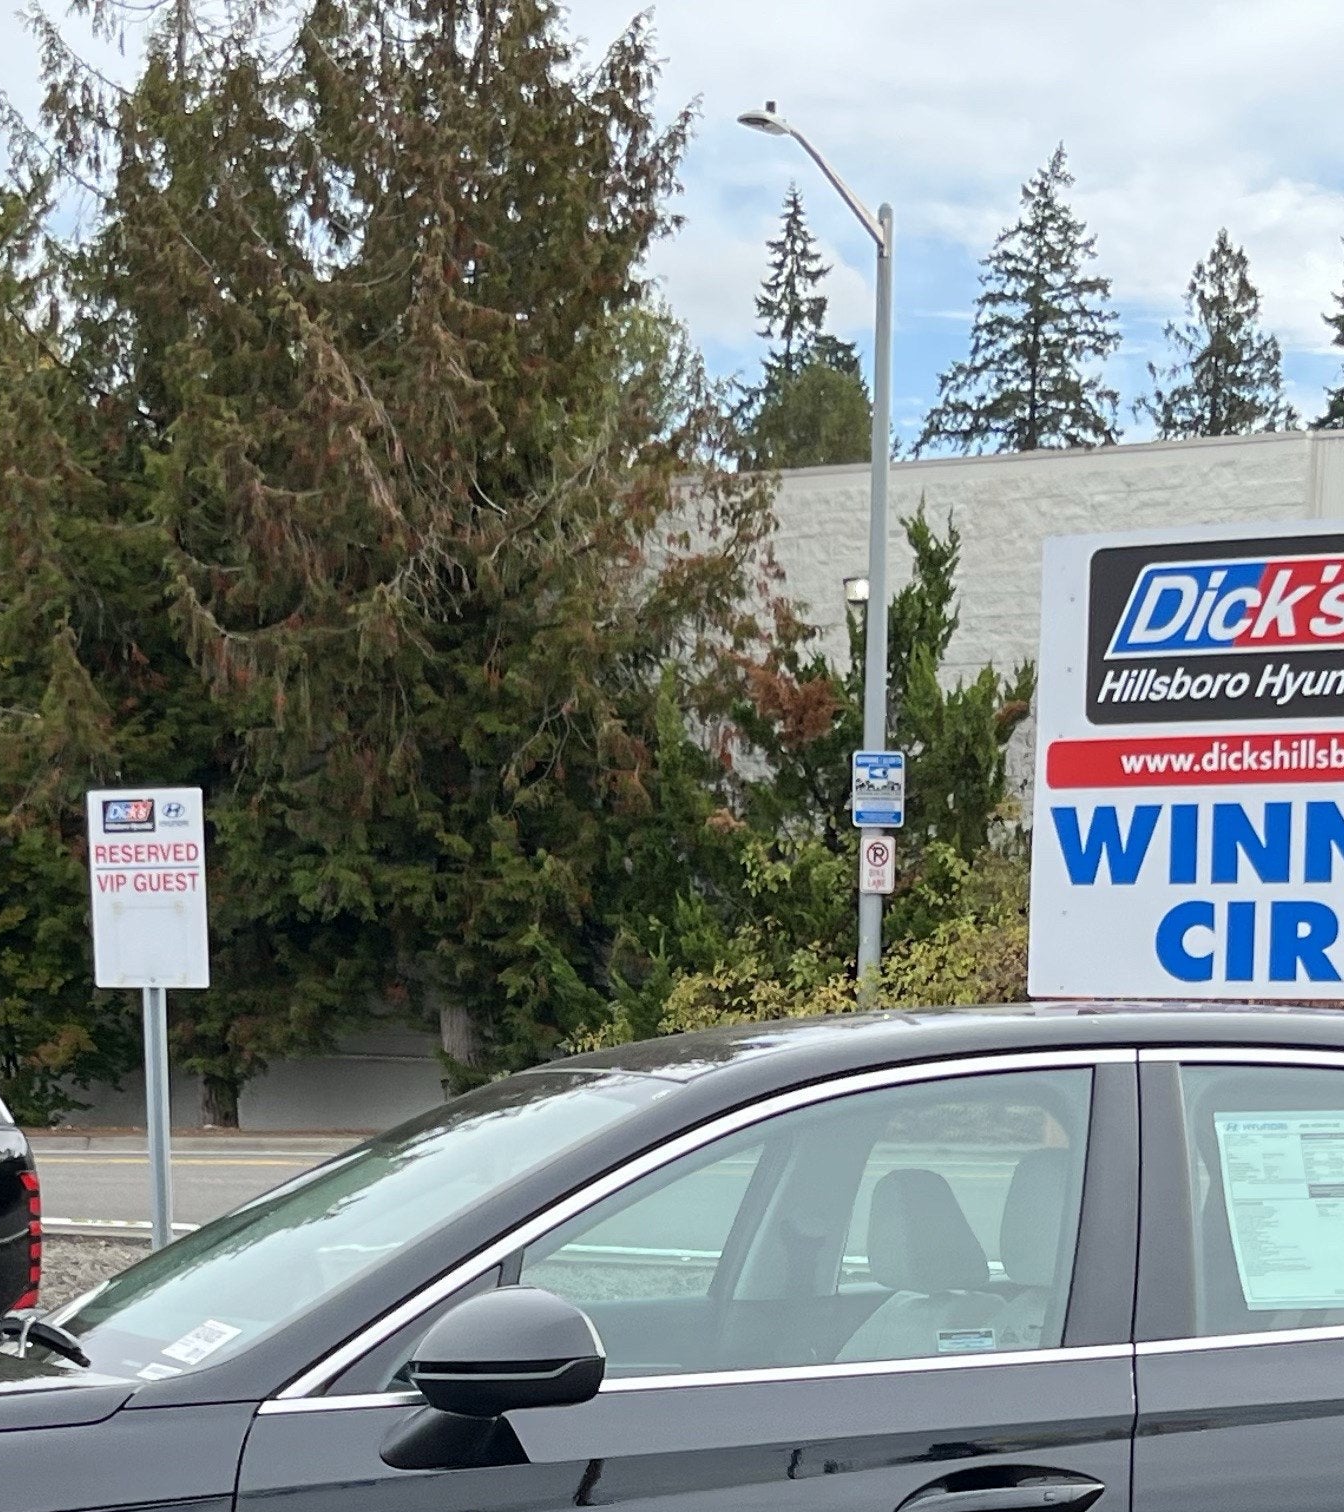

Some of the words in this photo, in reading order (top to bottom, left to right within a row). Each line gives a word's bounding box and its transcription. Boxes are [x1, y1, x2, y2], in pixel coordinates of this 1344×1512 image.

[1097, 667, 1249, 703] Hillsboro
[95, 843, 200, 863] RESERVED
[97, 874, 127, 892] VIP
[134, 872, 200, 892] GUEST
